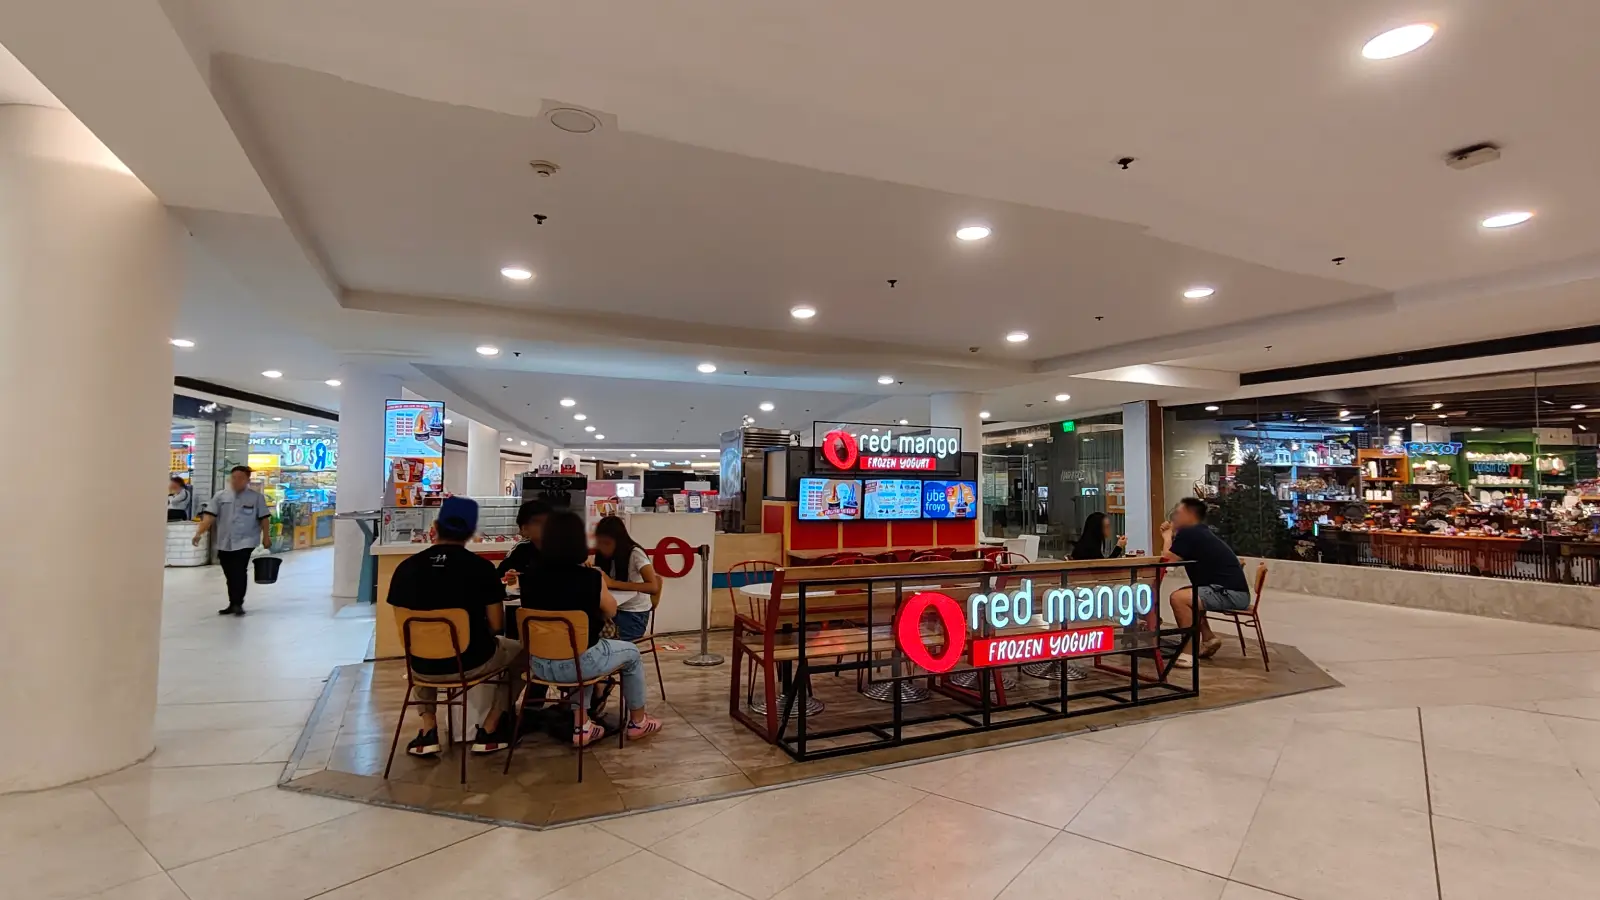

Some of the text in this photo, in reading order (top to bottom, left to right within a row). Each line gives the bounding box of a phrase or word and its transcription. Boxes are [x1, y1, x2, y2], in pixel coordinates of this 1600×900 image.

[859, 430, 958, 460] red mango
[867, 457, 931, 469] FROZEN YOGURT
[926, 489, 946, 502] ube
[925, 501, 946, 512] froyo
[970, 578, 1153, 631] red mango
[988, 631, 1104, 662] FROZEN YOGURT
